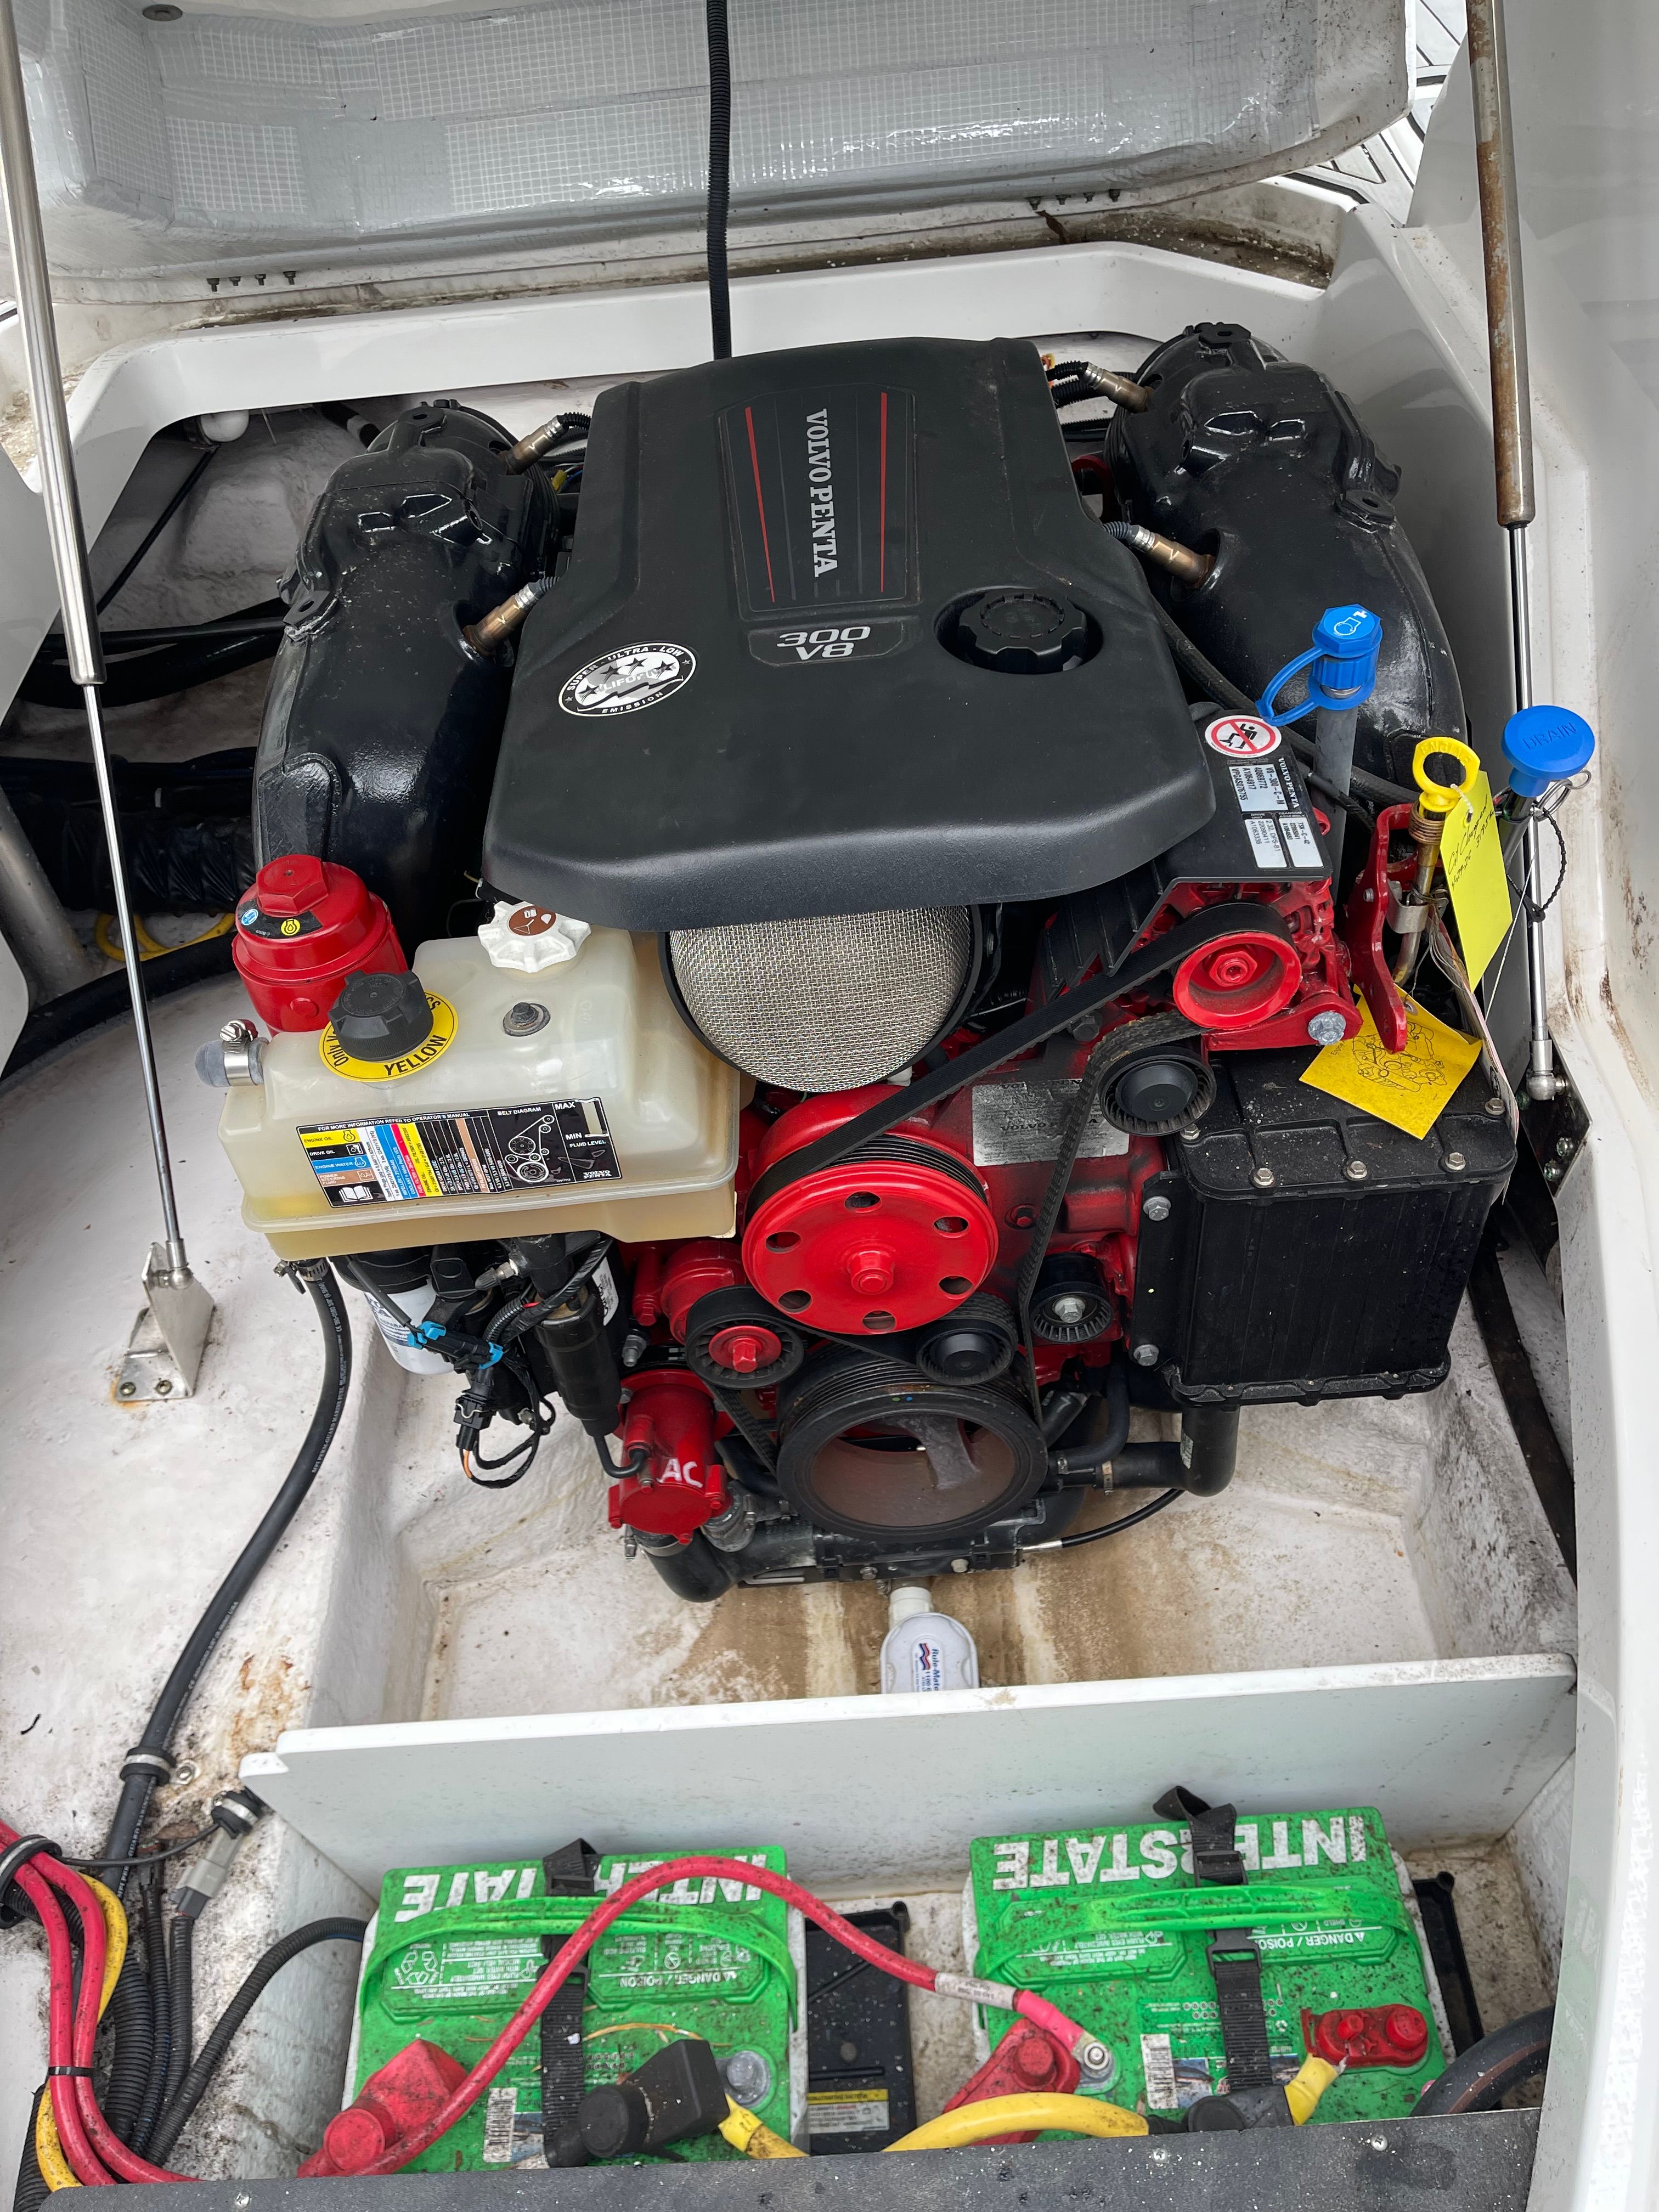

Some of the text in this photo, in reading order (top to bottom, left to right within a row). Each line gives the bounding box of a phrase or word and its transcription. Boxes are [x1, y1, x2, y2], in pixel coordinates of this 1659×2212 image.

[806, 408, 838, 577] VOLVO PENTA
[777, 626, 871, 647] 300
[796, 642, 854, 660] V8
[567, 646, 684, 691] SUPER ULTRA LOW
[602, 692, 663, 713] EMISSION
[1522, 723, 1577, 750] DRAIN
[1421, 741, 1473, 764] ENGINE
[1278, 757, 1291, 781] VOLVO
[1285, 781, 1300, 809] PENTA
[328, 1044, 349, 1067] Only
[384, 1035, 447, 1075] YELLOW
[347, 1120, 384, 1128] INFORMATION
[1001, 1122, 1046, 1131] VOLVO
[405, 1177, 416, 1194] COOLANT
[410, 1171, 424, 1194] FUEL FILTER
[422, 1179, 432, 1193] ENGINE
[435, 1170, 443, 1181] GEAR
[439, 1181, 448, 1192] DRIVE
[331, 1400, 342, 1422] MARINE
[657, 1458, 703, 1488] AC
[1254, 1937, 1295, 1950] POISO
[1306, 1933, 1354, 1946] DANGER
[619, 1975, 662, 1988] POISON
[674, 1972, 720, 1985] DANGER
